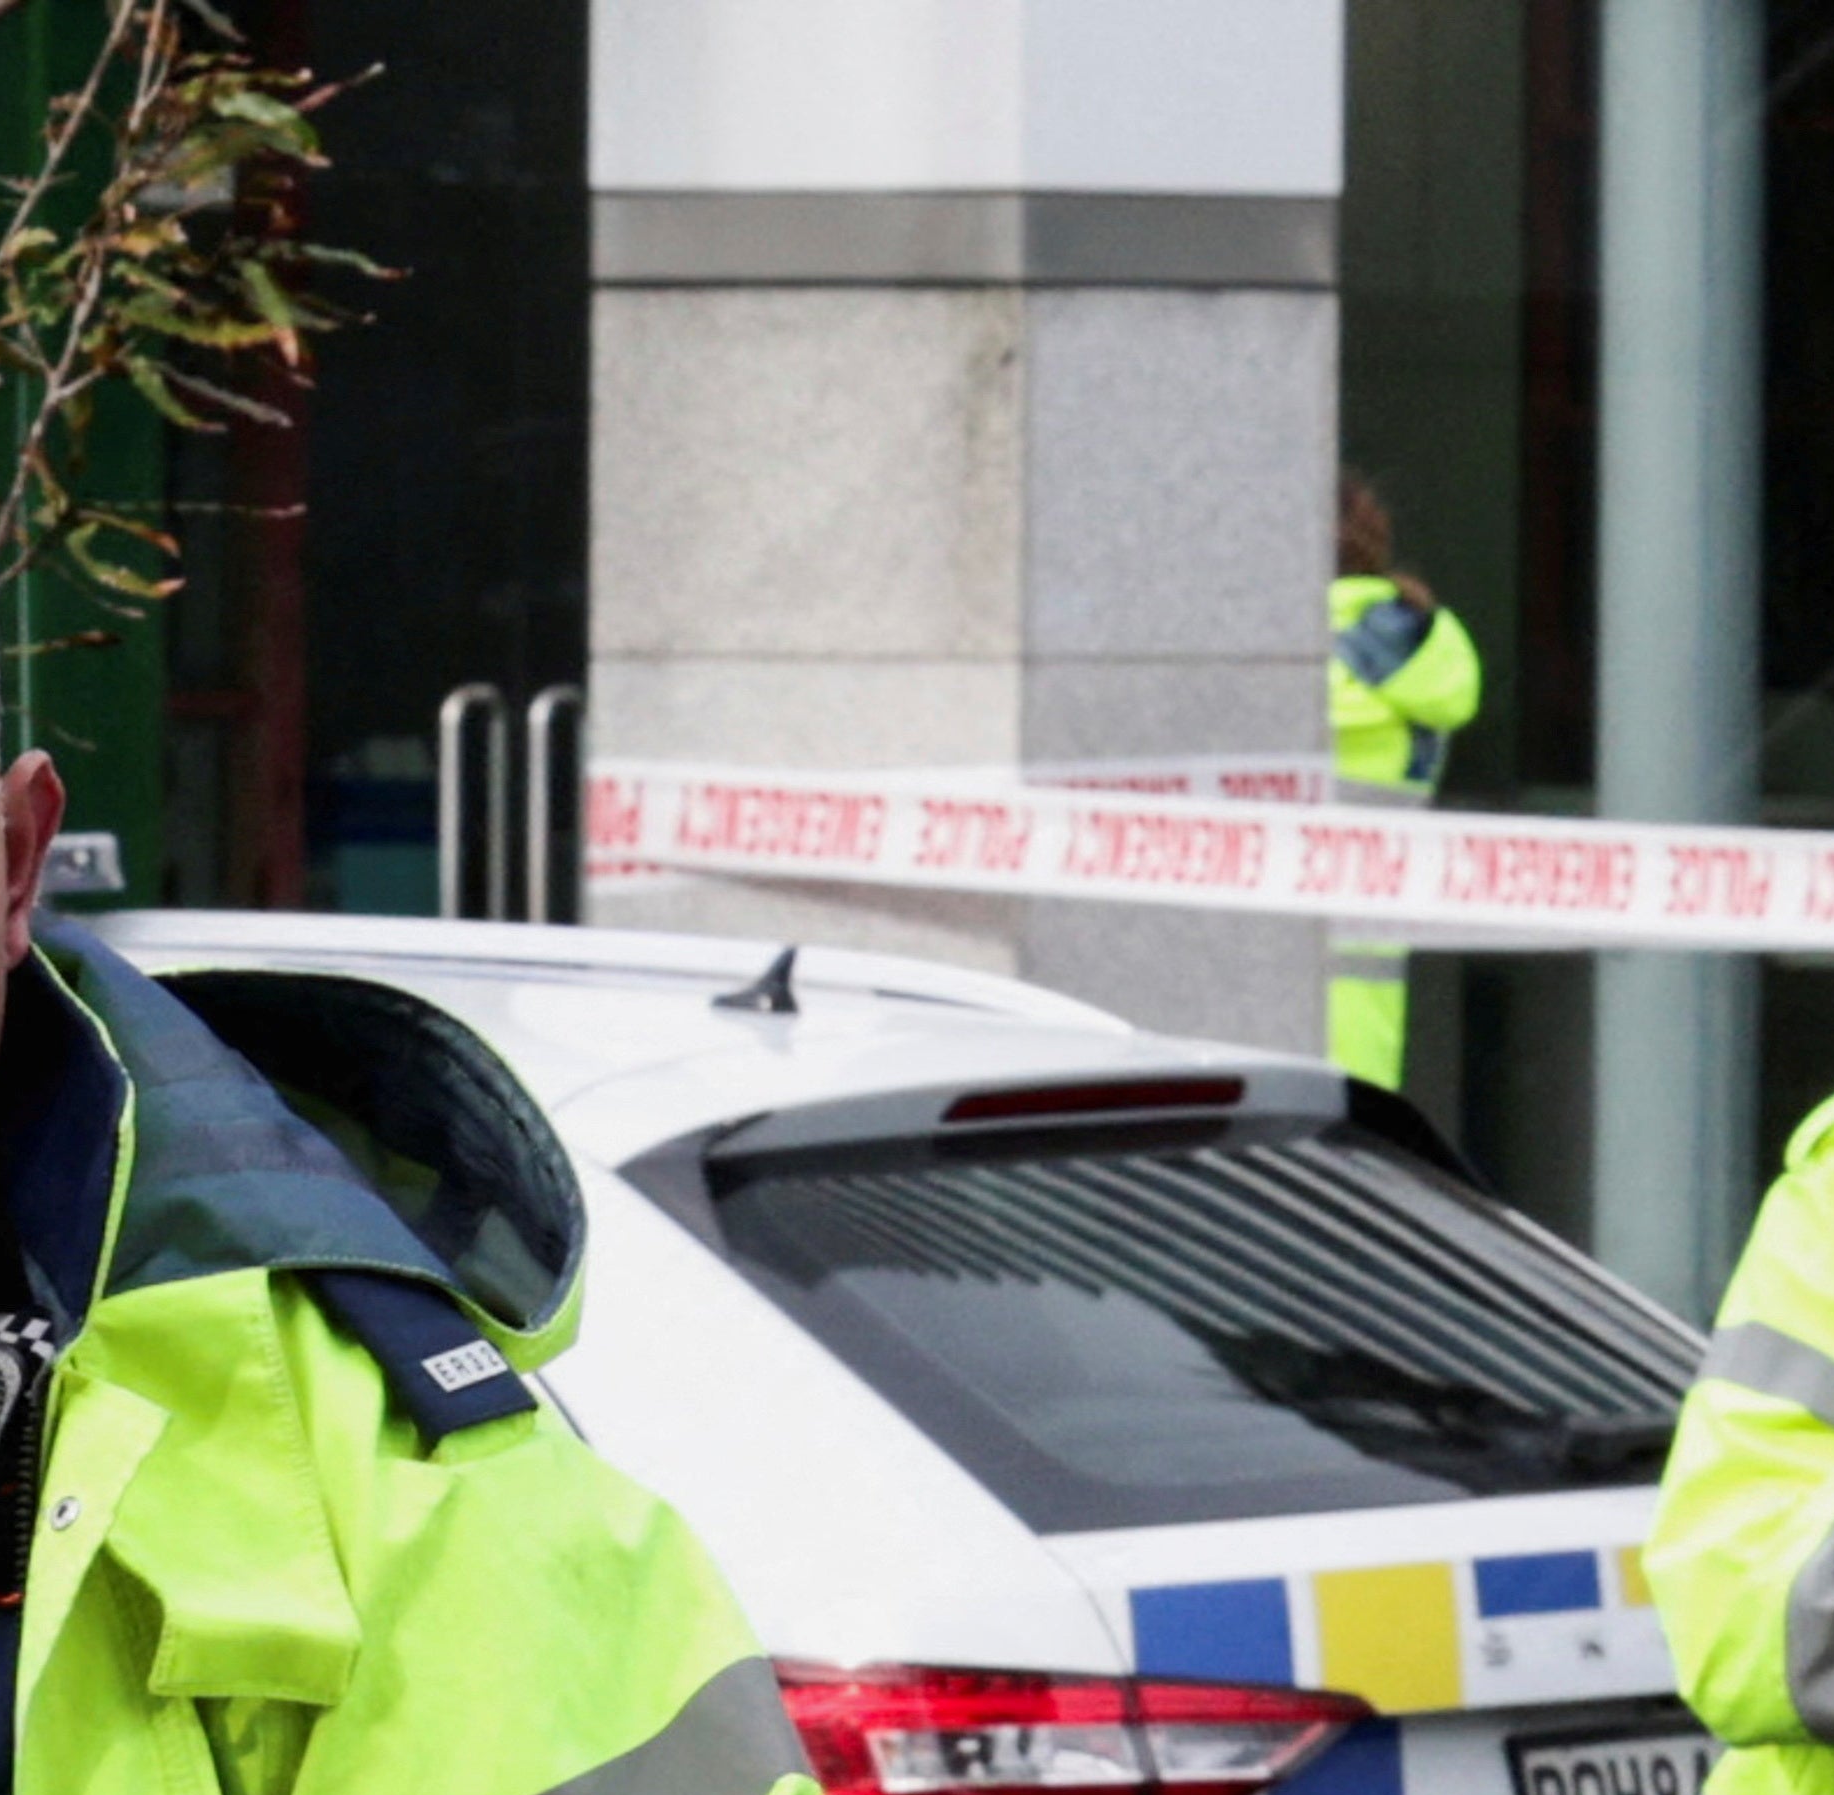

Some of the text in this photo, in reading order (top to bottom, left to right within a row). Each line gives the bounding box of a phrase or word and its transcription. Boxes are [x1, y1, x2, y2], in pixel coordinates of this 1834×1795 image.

[673, 782, 889, 861] EMERGENCY
[913, 797, 1032, 872] POLICE
[1062, 809, 1269, 885] EMERGENCY
[1297, 824, 1410, 896] POLICE
[1440, 834, 1637, 908] EMERGENCY
[1666, 844, 1773, 916] POLICE
